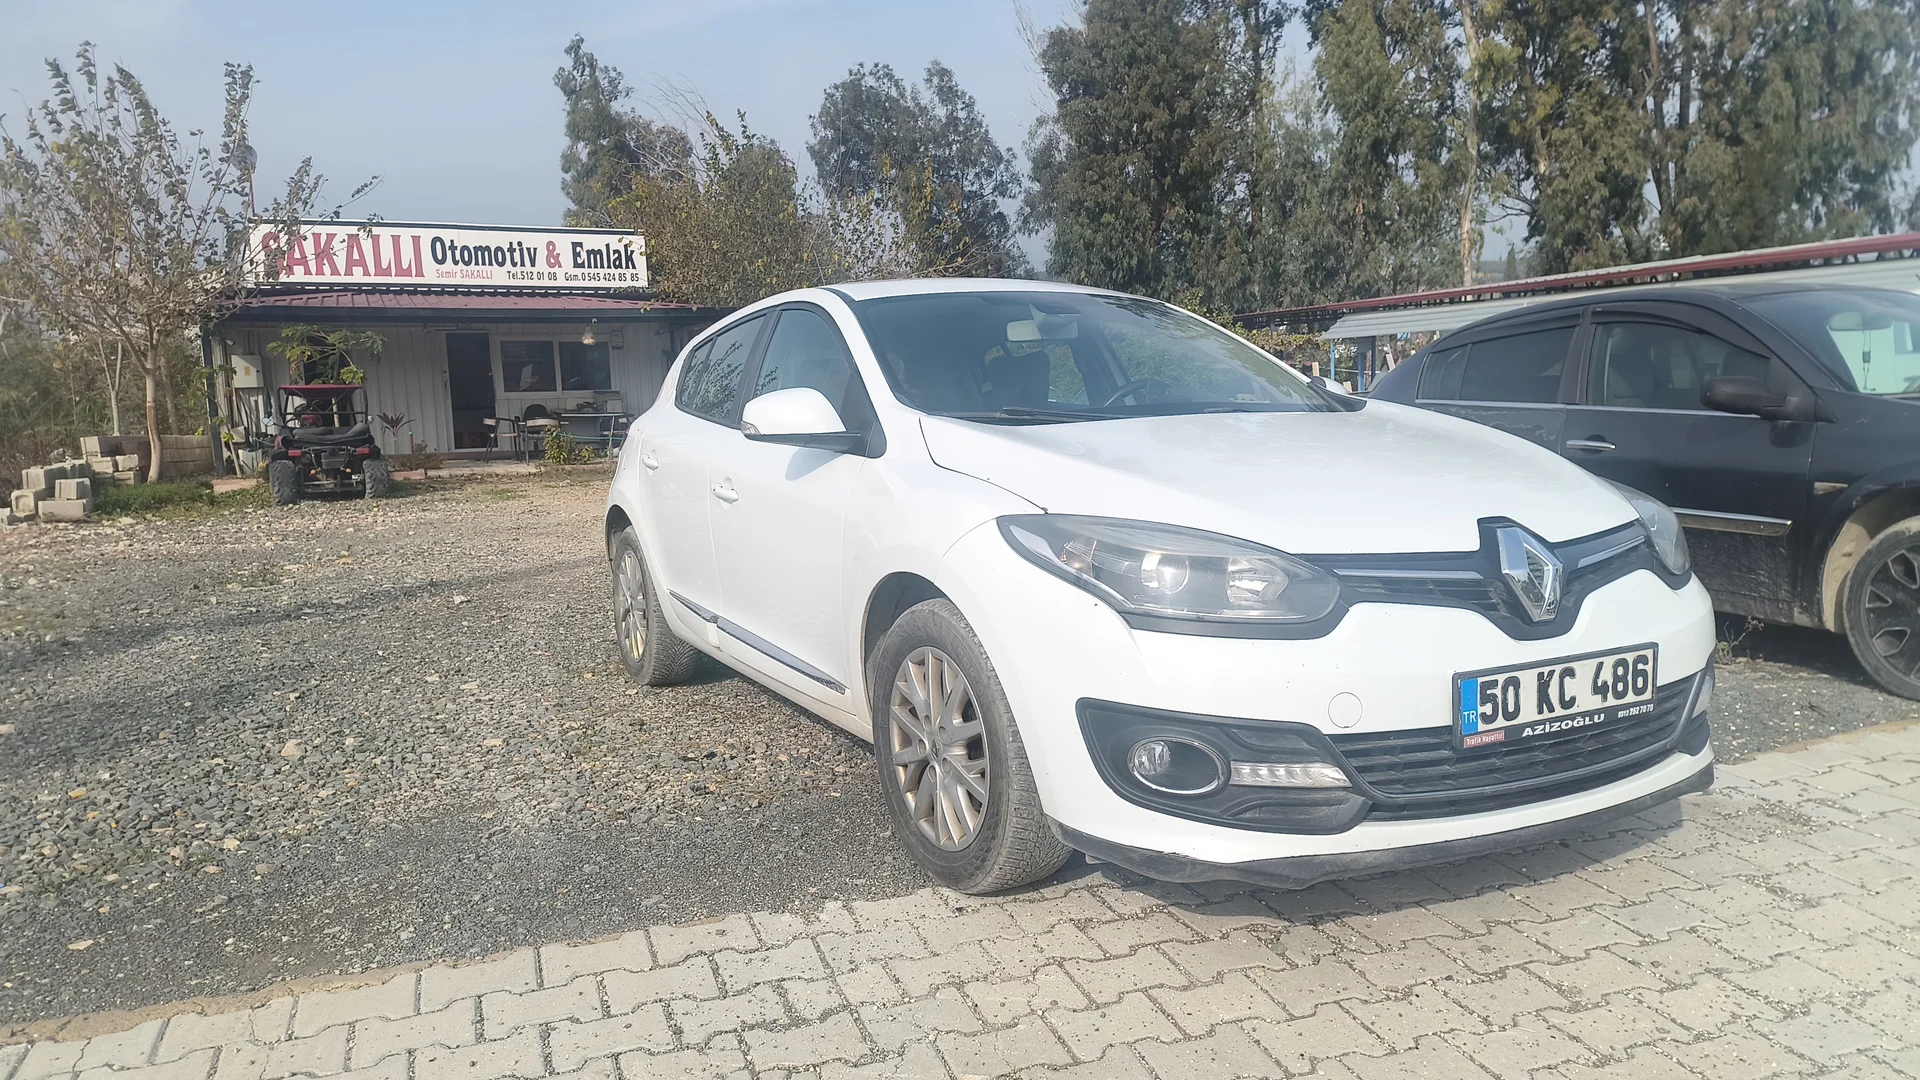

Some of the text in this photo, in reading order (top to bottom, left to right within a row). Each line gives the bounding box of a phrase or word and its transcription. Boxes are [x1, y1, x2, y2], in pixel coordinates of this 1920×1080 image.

[431, 236, 538, 267] Otomotiv
[545, 240, 562, 269] &
[570, 241, 637, 269] Emlak
[435, 269, 458, 279] Semir
[459, 269, 493, 280] SAKALLI
[536, 271, 545, 281] 01
[547, 271, 558, 281] 08
[602, 272, 616, 282] 424
[618, 272, 627, 282] 85
[630, 272, 639, 282] 85
[1478, 654, 1650, 725] 50 KC 486
[1463, 710, 1477, 724] TR
[1521, 713, 1605, 738] AZİZOĞLU
